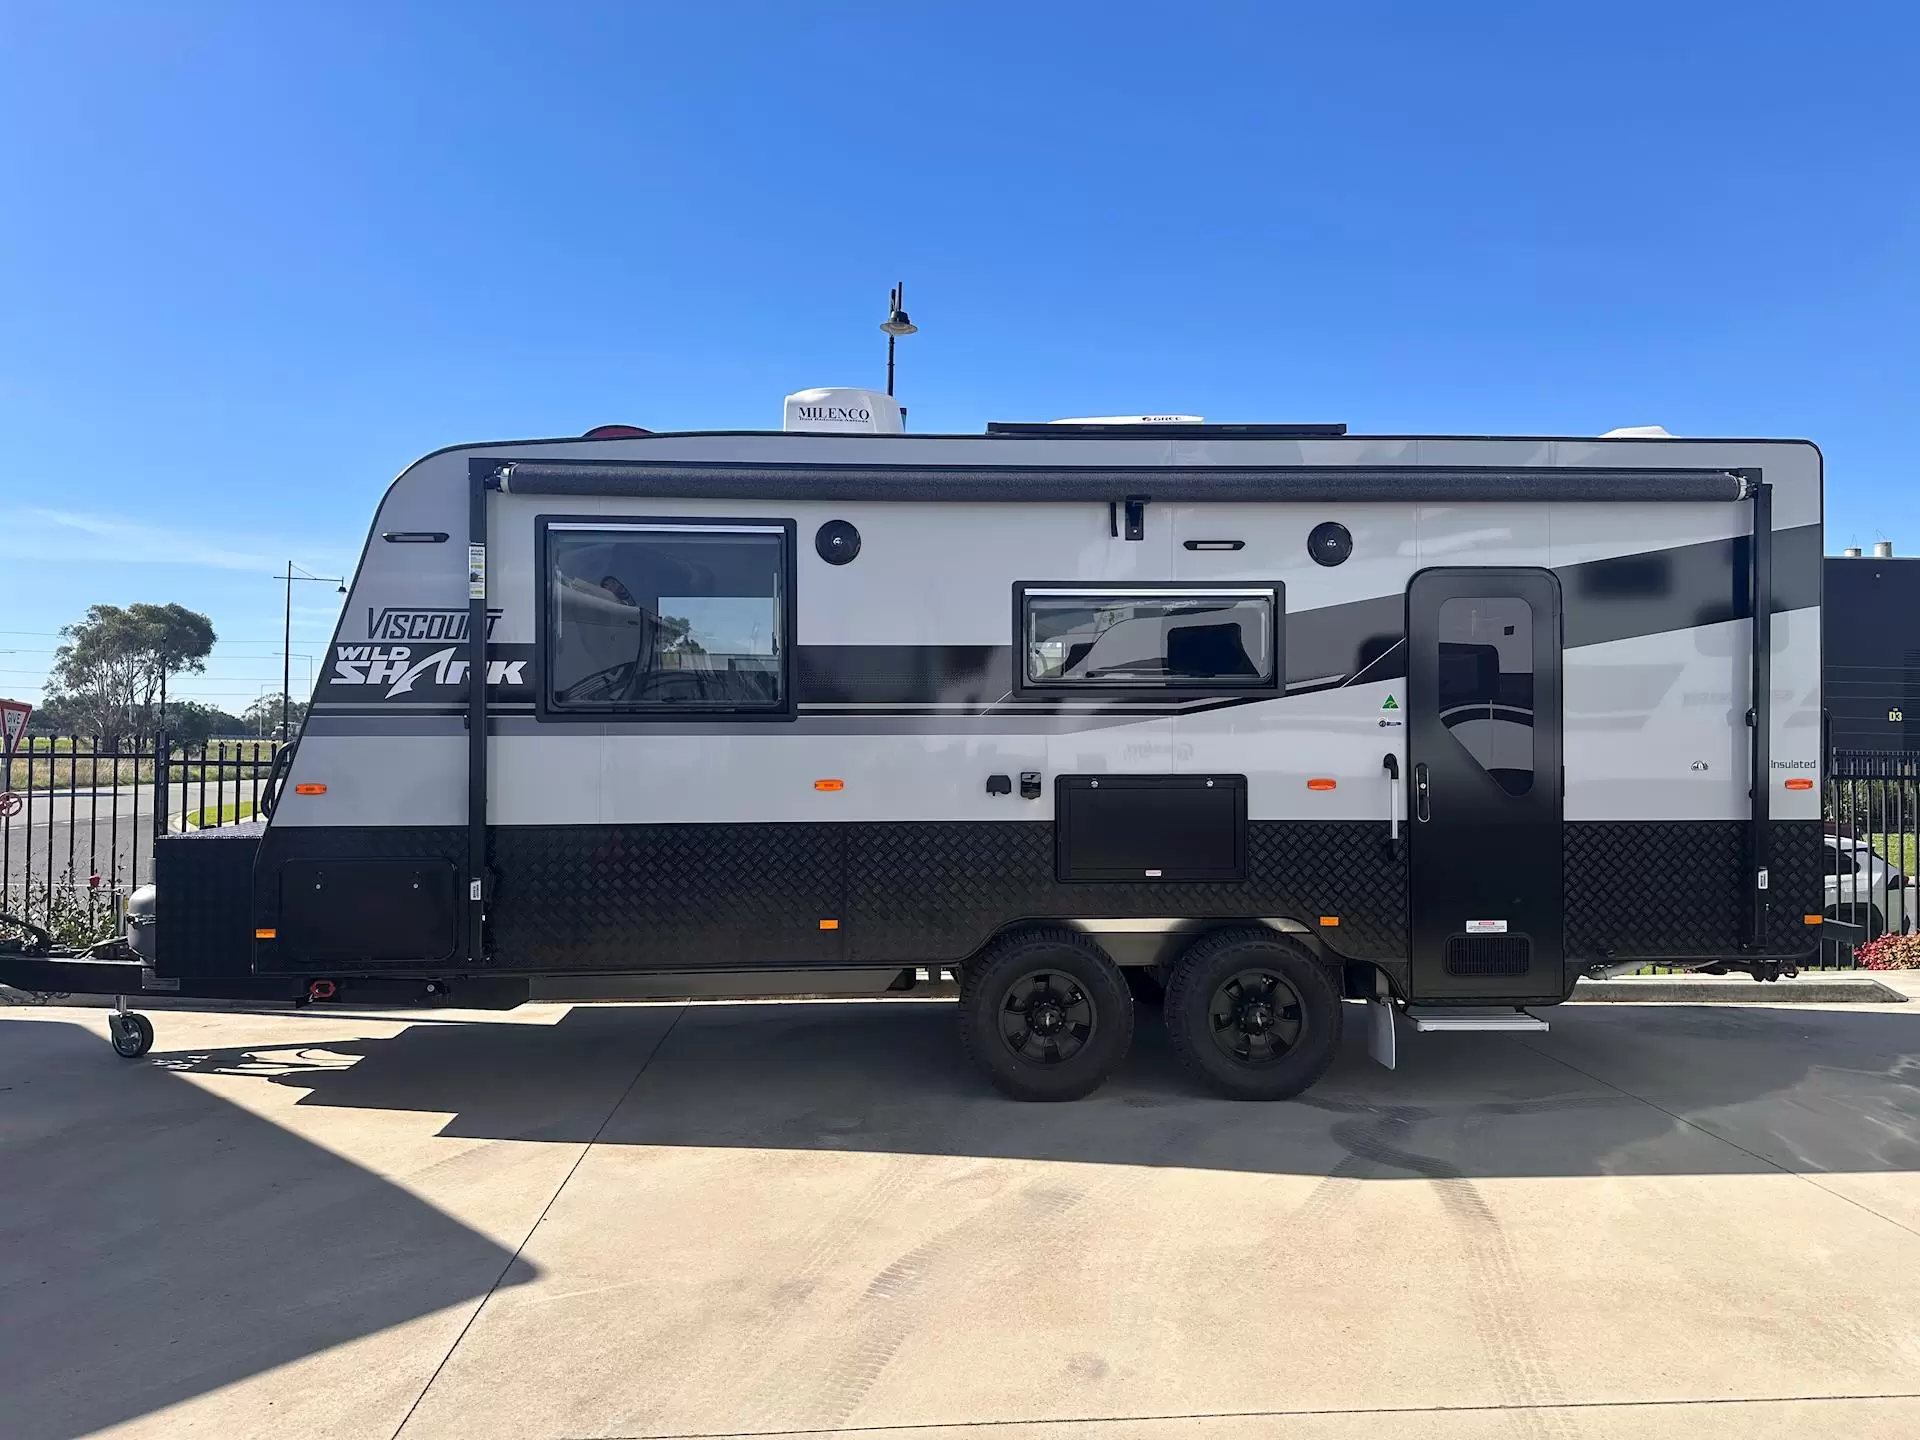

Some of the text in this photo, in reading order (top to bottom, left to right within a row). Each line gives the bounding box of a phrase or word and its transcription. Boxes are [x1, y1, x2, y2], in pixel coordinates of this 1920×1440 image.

[798, 407, 870, 420] MILENCO
[368, 607, 504, 640] VISCOUT
[336, 646, 412, 661] WILD
[7, 711, 21, 725] GIVE
[1888, 711, 1903, 722] D3
[1770, 759, 1817, 769] Insulated
